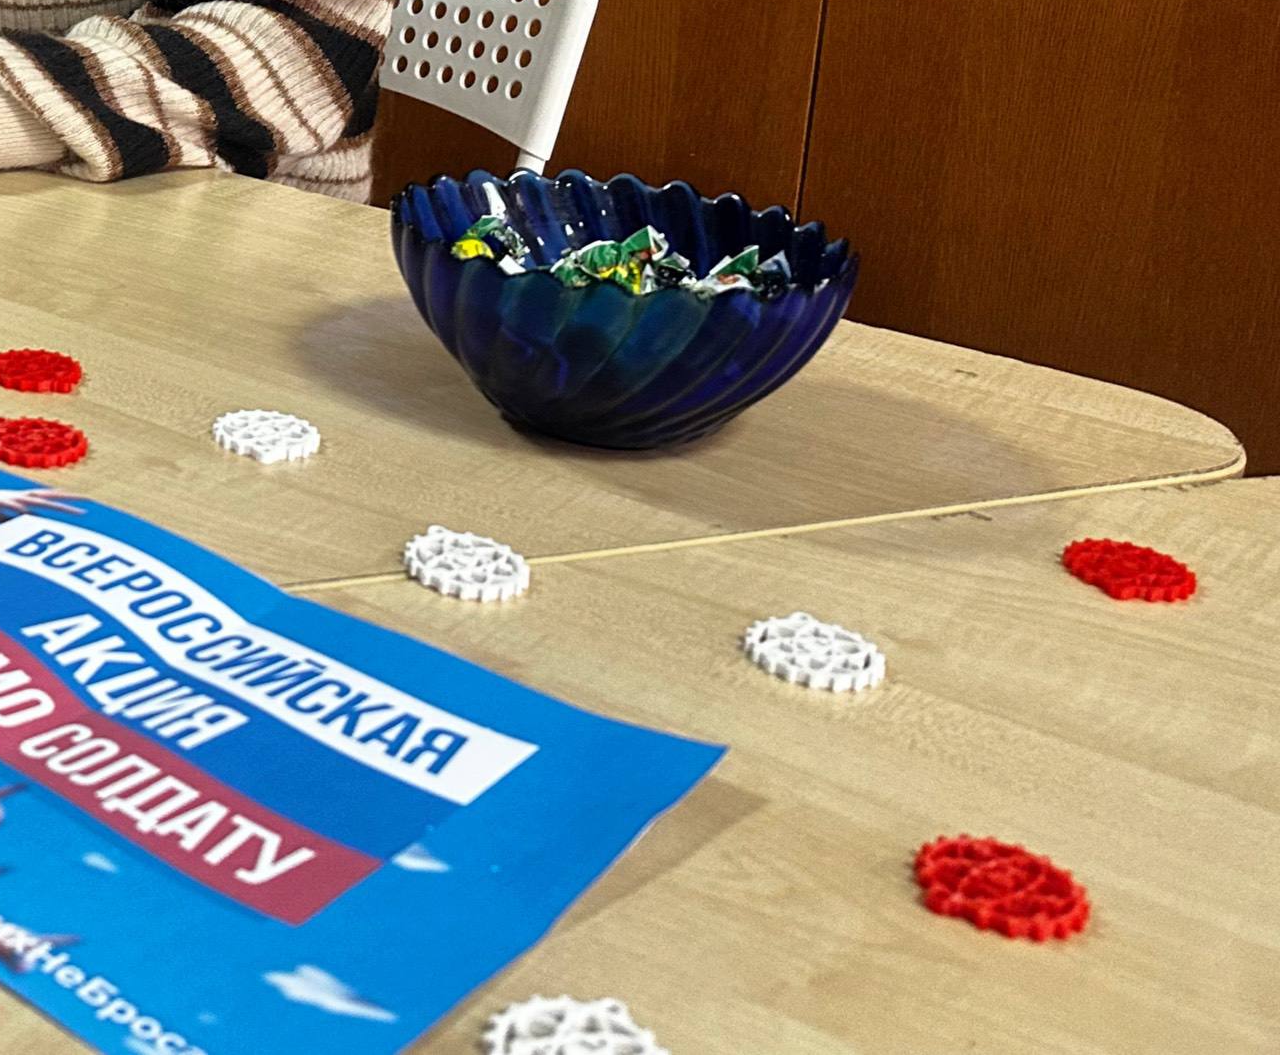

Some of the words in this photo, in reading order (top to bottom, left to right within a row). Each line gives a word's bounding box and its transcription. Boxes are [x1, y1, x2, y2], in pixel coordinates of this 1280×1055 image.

[6, 528, 469, 777] ВСЕРОССИЙСКАЯ
[20, 612, 250, 749] АКЦИЯ
[20, 722, 317, 887] СОЛДАТУ
